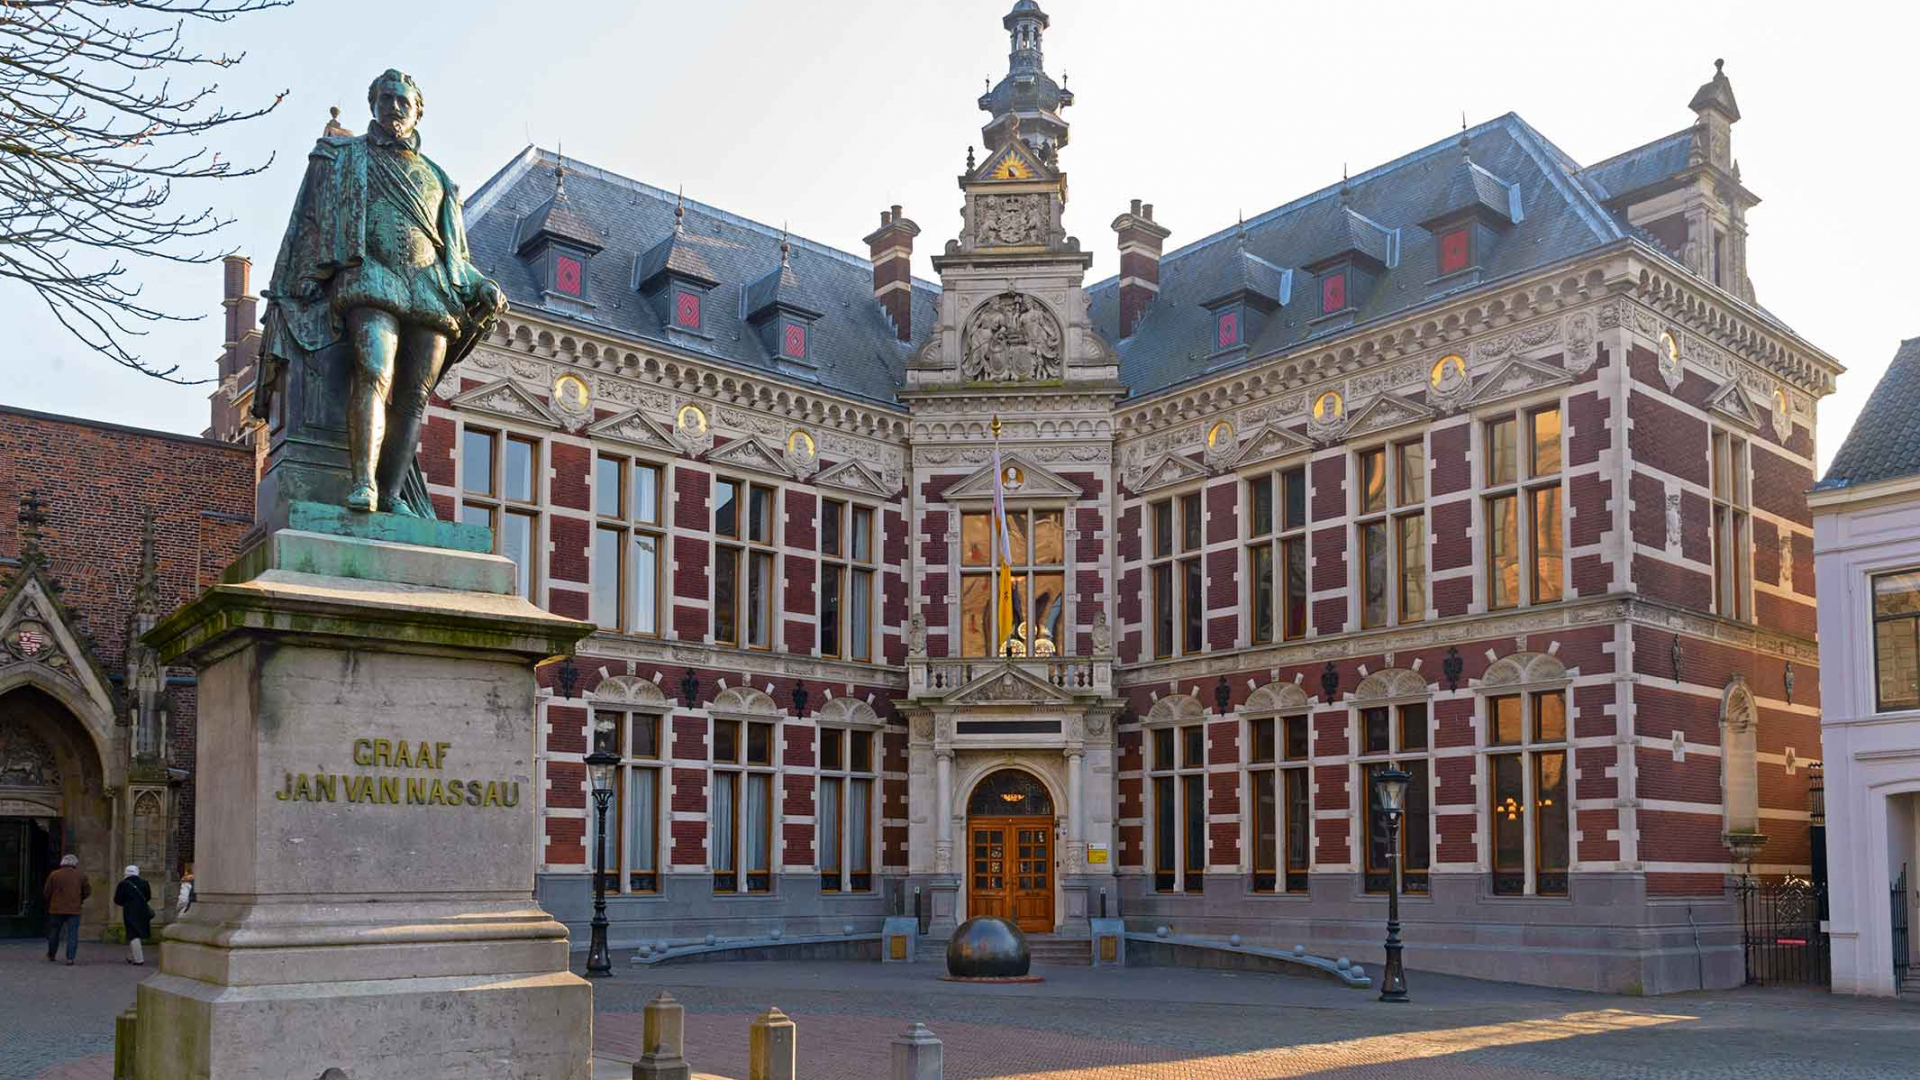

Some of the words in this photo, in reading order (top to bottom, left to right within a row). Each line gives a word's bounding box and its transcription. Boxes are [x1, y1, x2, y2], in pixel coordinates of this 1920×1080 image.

[353, 738, 451, 769] GRAAF
[275, 772, 337, 802] JAN
[342, 774, 399, 805] VAN
[406, 777, 520, 808] NASSAU
